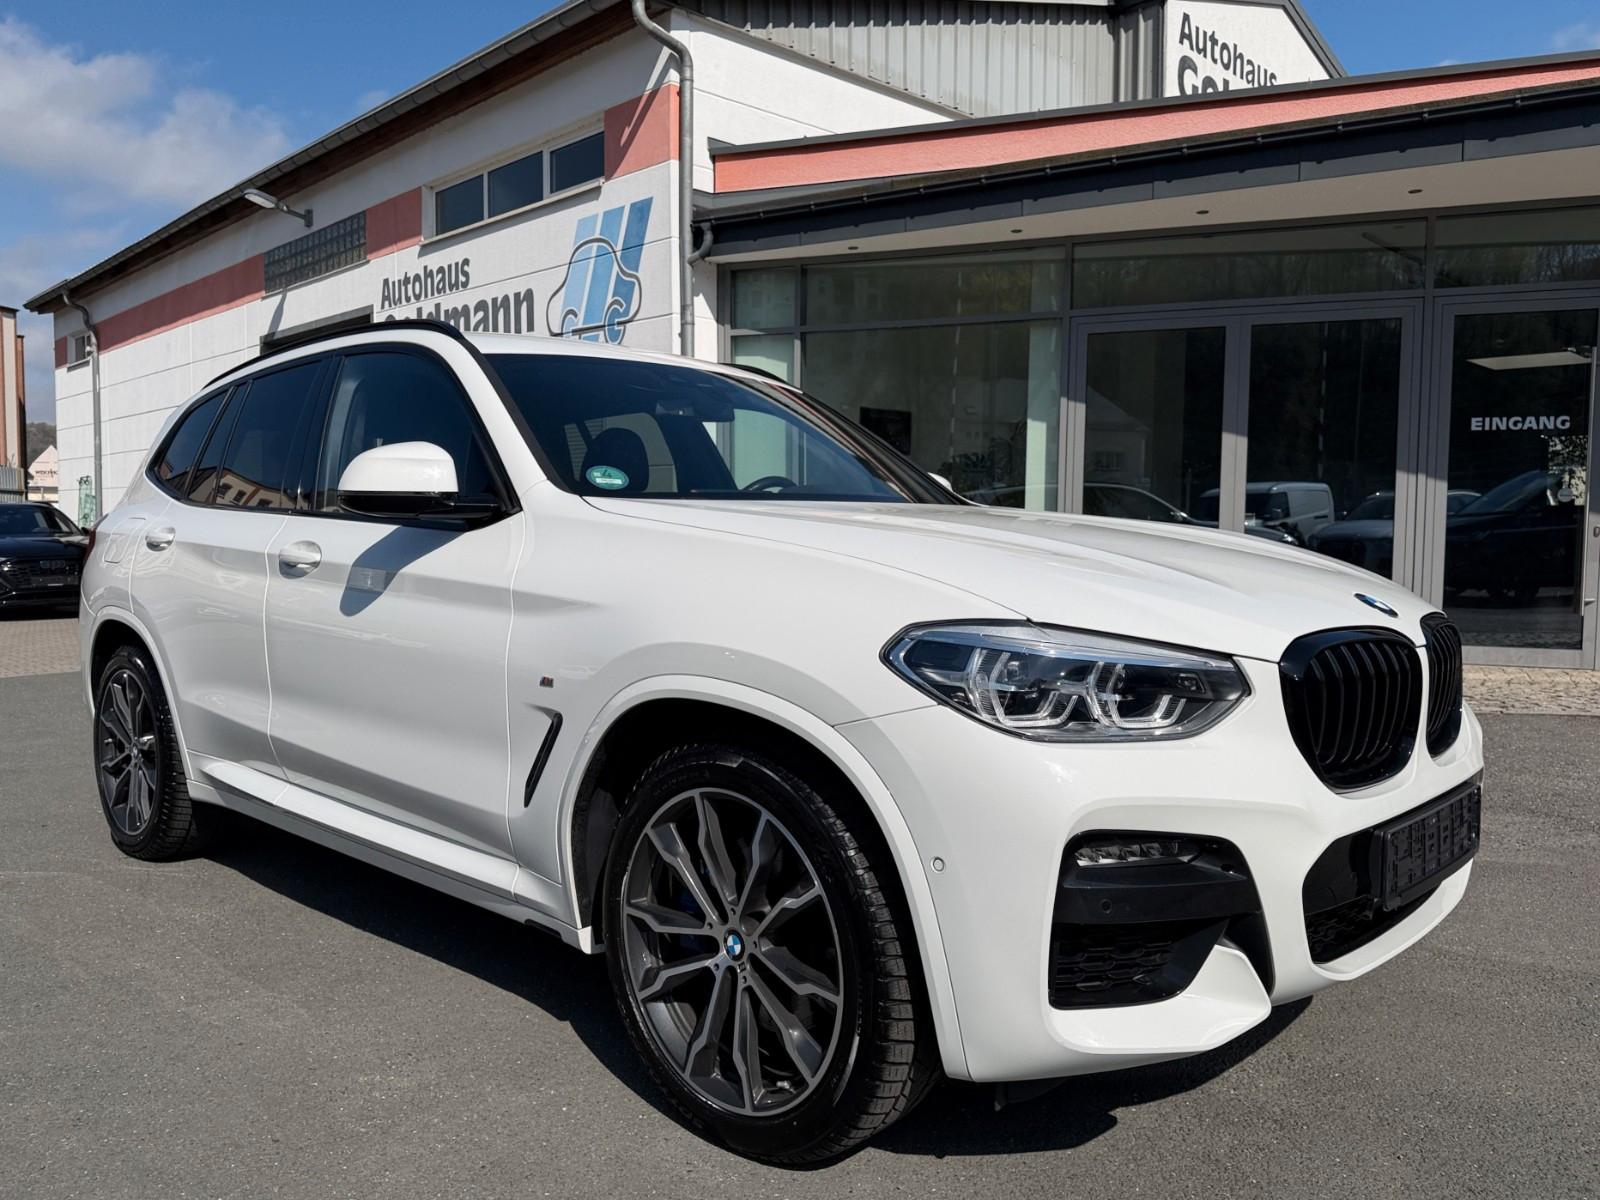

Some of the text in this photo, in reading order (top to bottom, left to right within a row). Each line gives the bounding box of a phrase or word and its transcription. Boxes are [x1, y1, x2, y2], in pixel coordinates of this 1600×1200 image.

[1179, 12, 1277, 87] Autohaus
[381, 257, 470, 310] Autohaus
[1471, 415, 1571, 431] EINGANG
